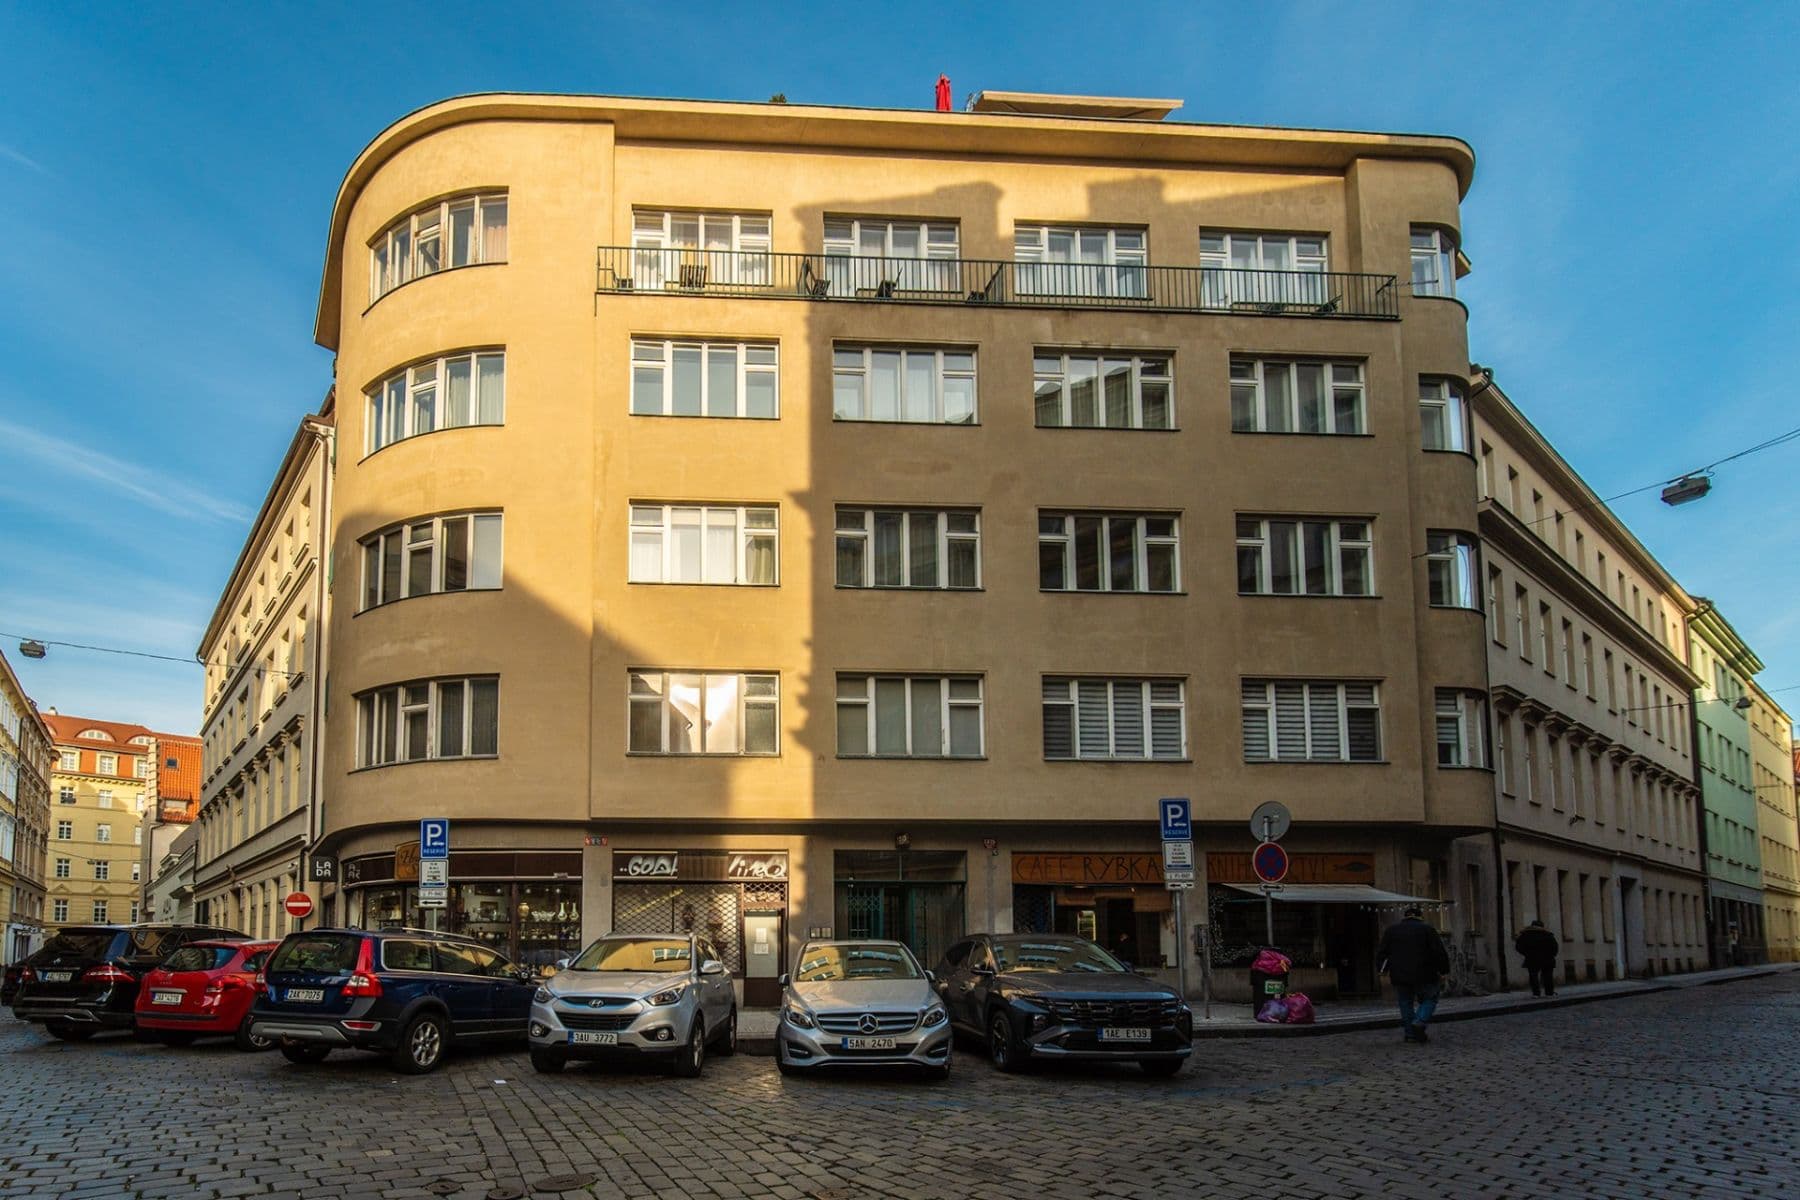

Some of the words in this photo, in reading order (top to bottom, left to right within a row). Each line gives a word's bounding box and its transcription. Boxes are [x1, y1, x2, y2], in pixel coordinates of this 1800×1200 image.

[1166, 804, 1184, 827] P
[426, 824, 442, 847] P
[316, 861, 331, 869] LA
[1083, 856, 1163, 881] RYBKA
[316, 869, 331, 877] DA
[575, 1033, 590, 1042] 3AU
[594, 1033, 615, 1043] 3772
[849, 1039, 866, 1048] 5AN
[871, 1039, 894, 1048] 2470
